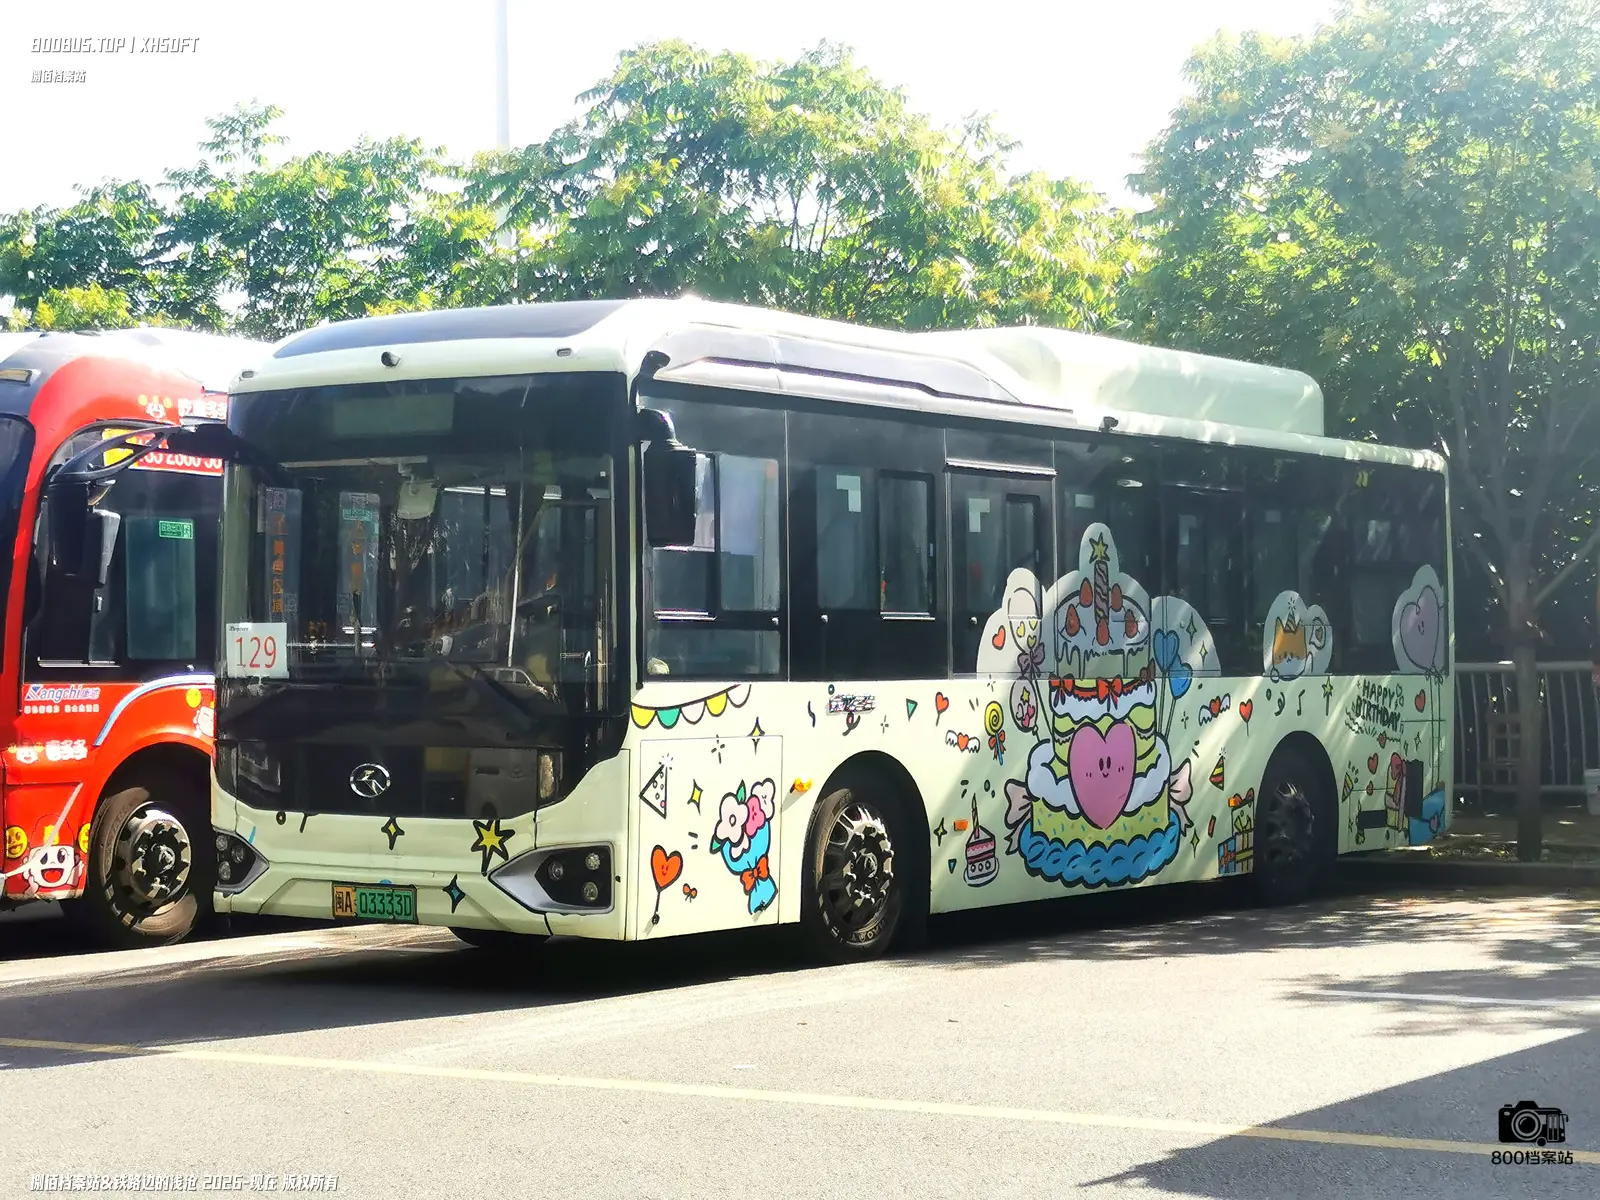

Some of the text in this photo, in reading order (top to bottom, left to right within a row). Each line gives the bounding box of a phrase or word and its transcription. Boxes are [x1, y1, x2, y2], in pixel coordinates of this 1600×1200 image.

[235, 635, 277, 669] 129
[1362, 679, 1395, 708] HAPPY
[1355, 695, 1401, 733] BIRTHDAY
[360, 892, 412, 917] 03333D
